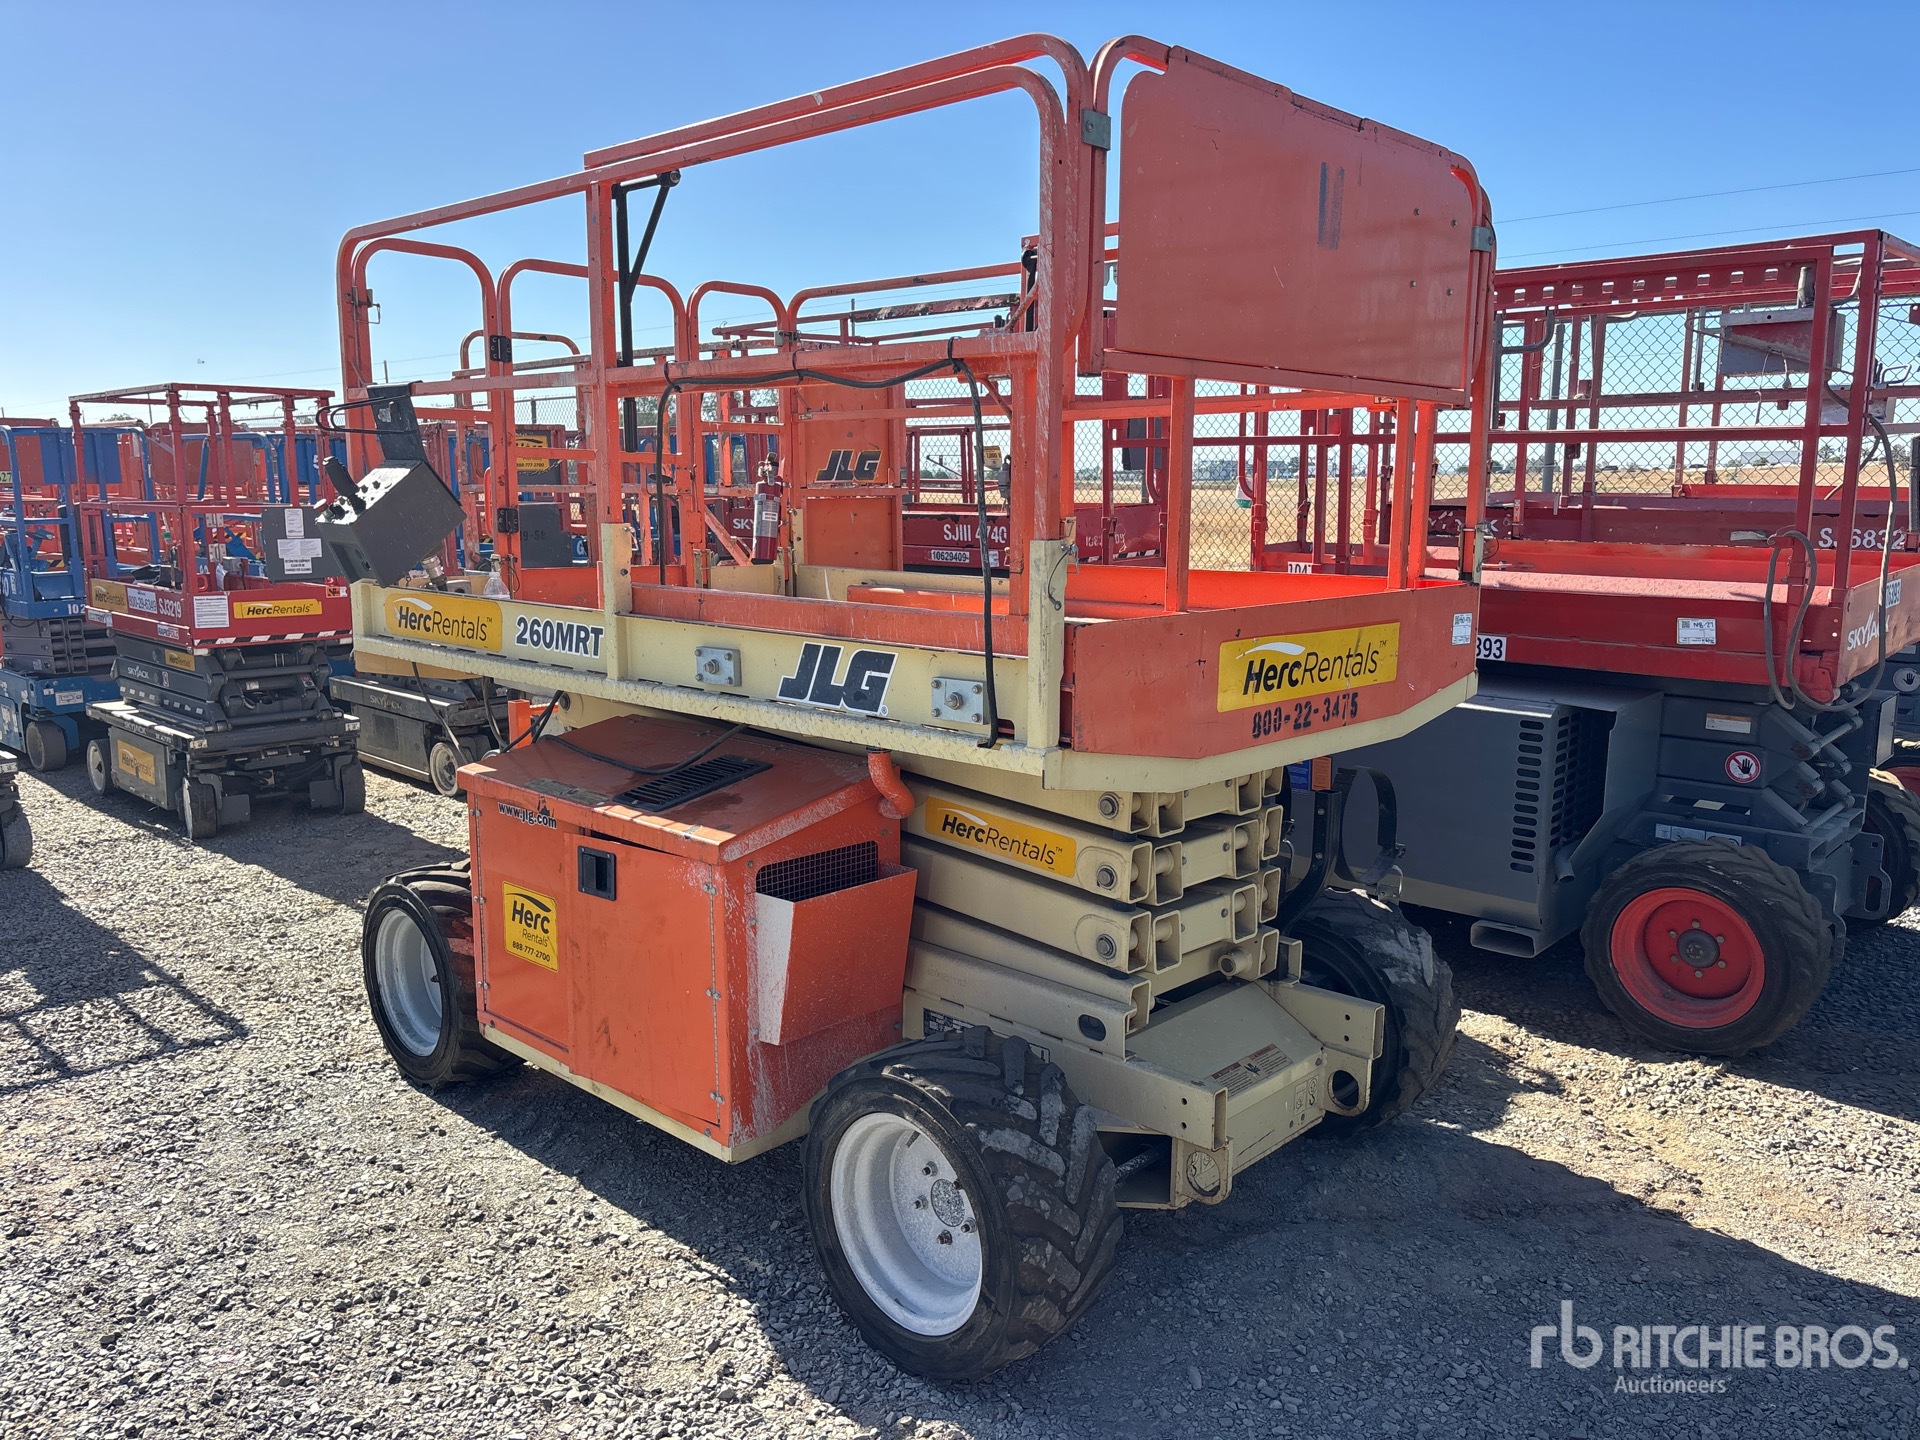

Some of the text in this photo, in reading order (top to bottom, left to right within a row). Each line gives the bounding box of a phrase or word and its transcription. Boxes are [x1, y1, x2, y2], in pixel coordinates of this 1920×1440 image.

[816, 449, 882, 482] JLG
[1818, 527, 1905, 550] S6832
[158, 597, 182, 618] SJ3219
[515, 615, 605, 659] 260MRT
[776, 641, 899, 715] JLG
[498, 803, 558, 829] www.jlg.com
[512, 900, 550, 934] Herc
[512, 940, 551, 962] 888-777-2700
[522, 929, 549, 947] Rentals
